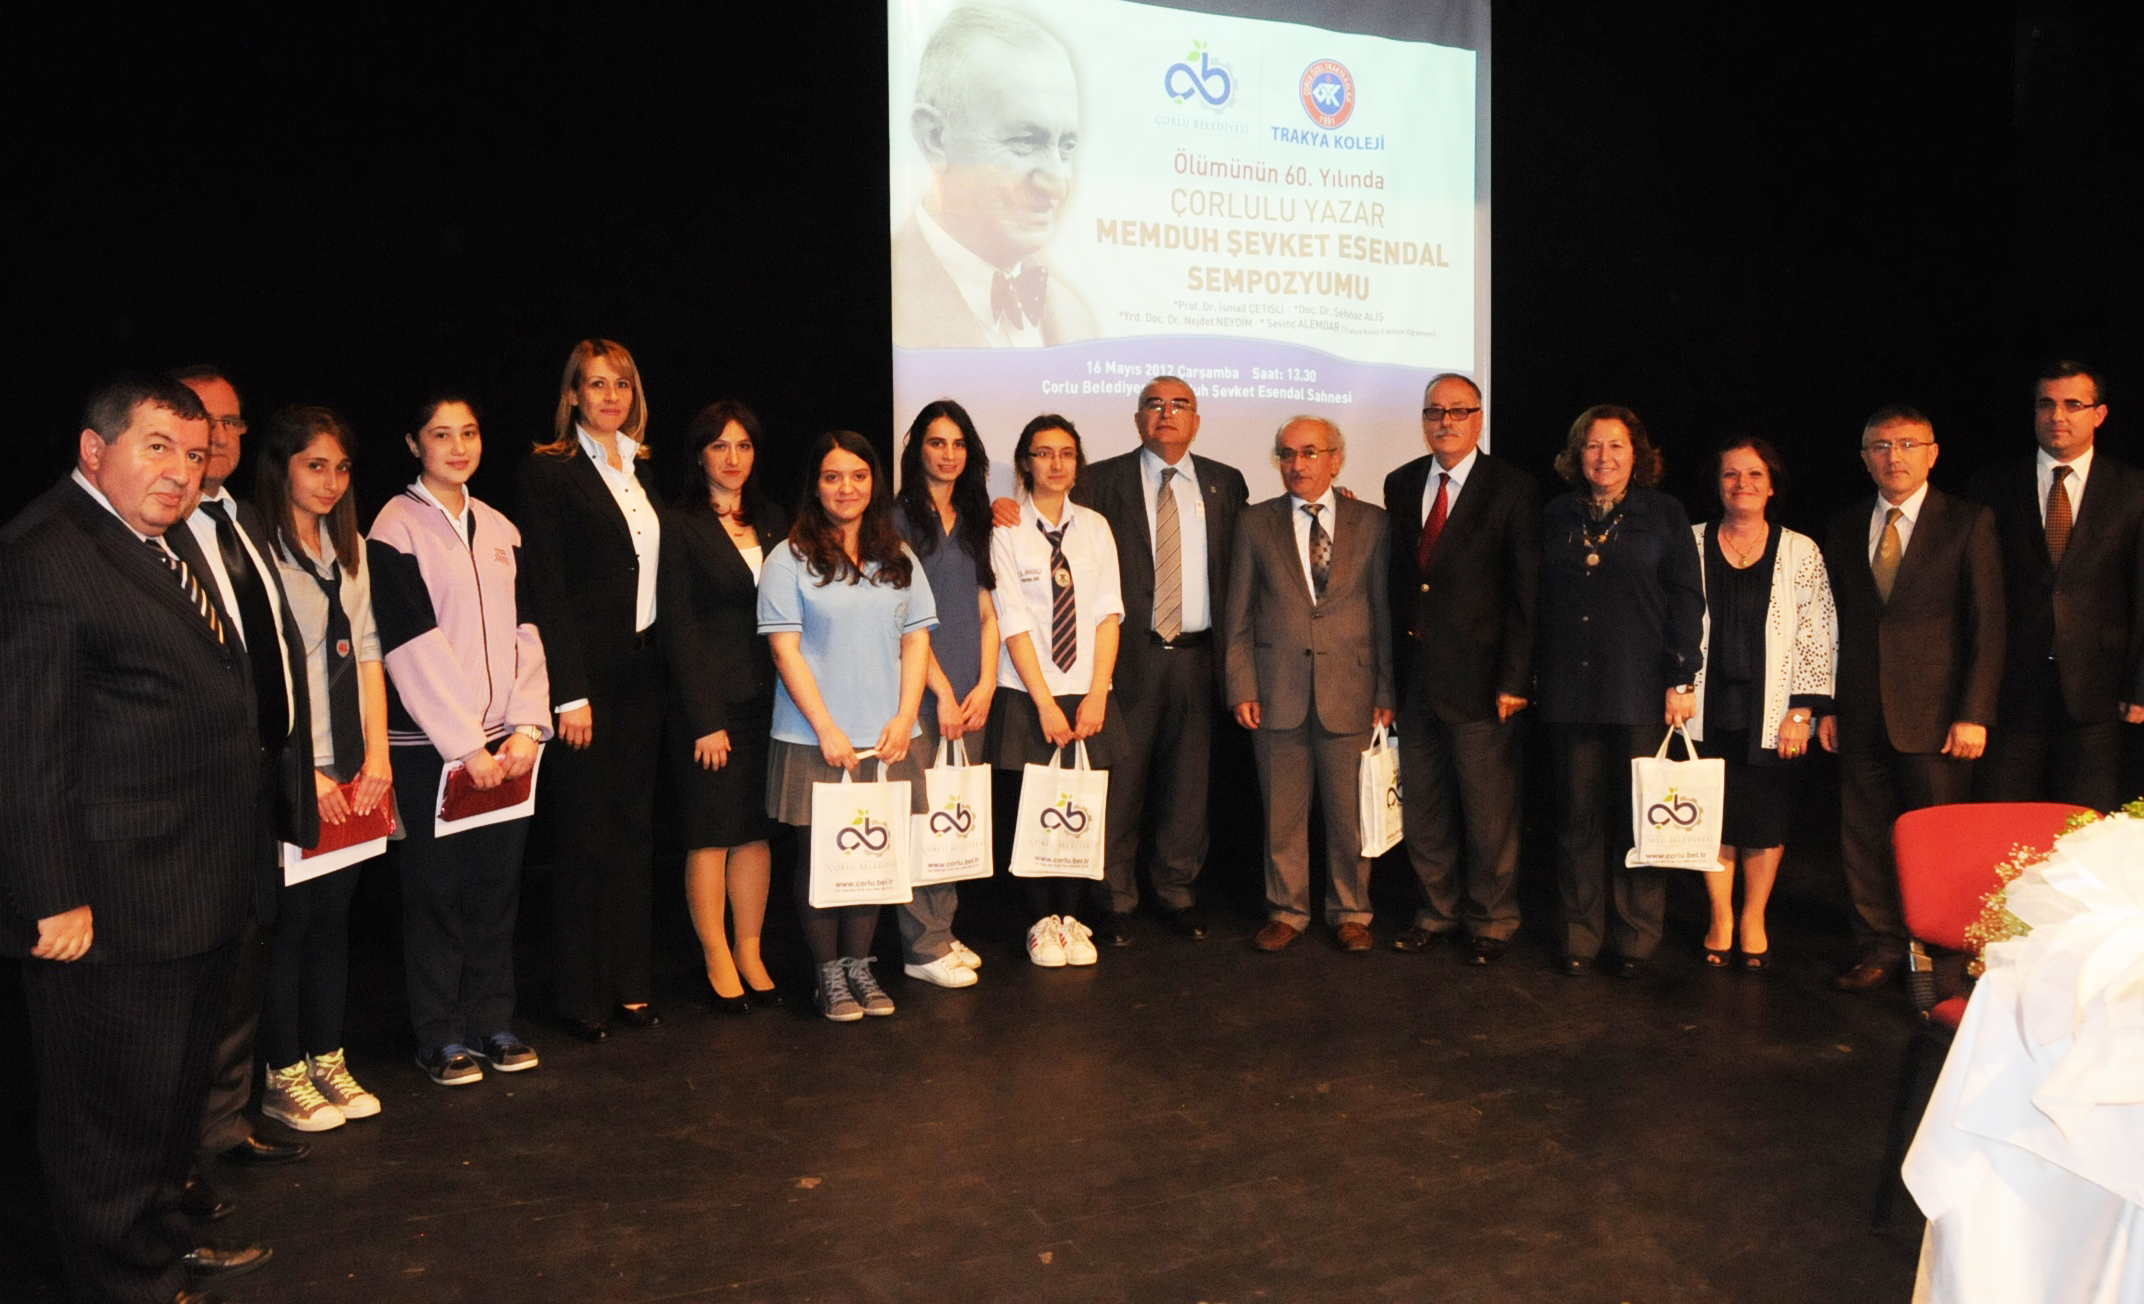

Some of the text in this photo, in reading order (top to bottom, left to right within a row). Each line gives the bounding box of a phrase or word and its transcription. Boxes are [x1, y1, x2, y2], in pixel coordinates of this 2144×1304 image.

[1154, 115, 1249, 134] ÇORLU BELEDİYESİ
[1271, 126, 1385, 151] TRAKYA KOLEJİ
[1174, 148, 1385, 190] Ölümünün 60. Yılında
[1171, 188, 1385, 229] ÇORLULU YAZAR
[1096, 218, 1449, 268] MEMDUH ŞEVKET ESENDAL
[1187, 265, 1370, 302] SEMPOZYUMU
[1146, 313, 1165, 325] Doç.
[1168, 314, 1182, 325] Dr.
[1184, 316, 1214, 328] Nejdet
[1217, 316, 1253, 328] NEYDİM
[1267, 319, 1296, 329] Sevinç
[1298, 319, 1340, 332] ALEMDAR
[1203, 302, 1217, 312] Dr.
[1219, 302, 1247, 313] İsmail
[1249, 303, 1284, 315] ÇETİŞLİ
[1320, 305, 1332, 316] Dr.
[1334, 307, 1363, 321] Şehnaz
[1086, 361, 1317, 383] 16 Mayıs 2012 Çarşamba Saat: 13.30
[1042, 379, 1079, 395] Çorlu
[1082, 380, 1144, 397] Belediye
[1212, 384, 1255, 399] Şevket
[1258, 385, 1304, 401] Esendal
[1307, 388, 1353, 404] Sahnesi
[928, 857, 979, 868] www.corlu.bel.tr
[1034, 855, 1090, 864] www.corlu.bel.tr
[835, 878, 893, 888] www.corlu.bel.tr
